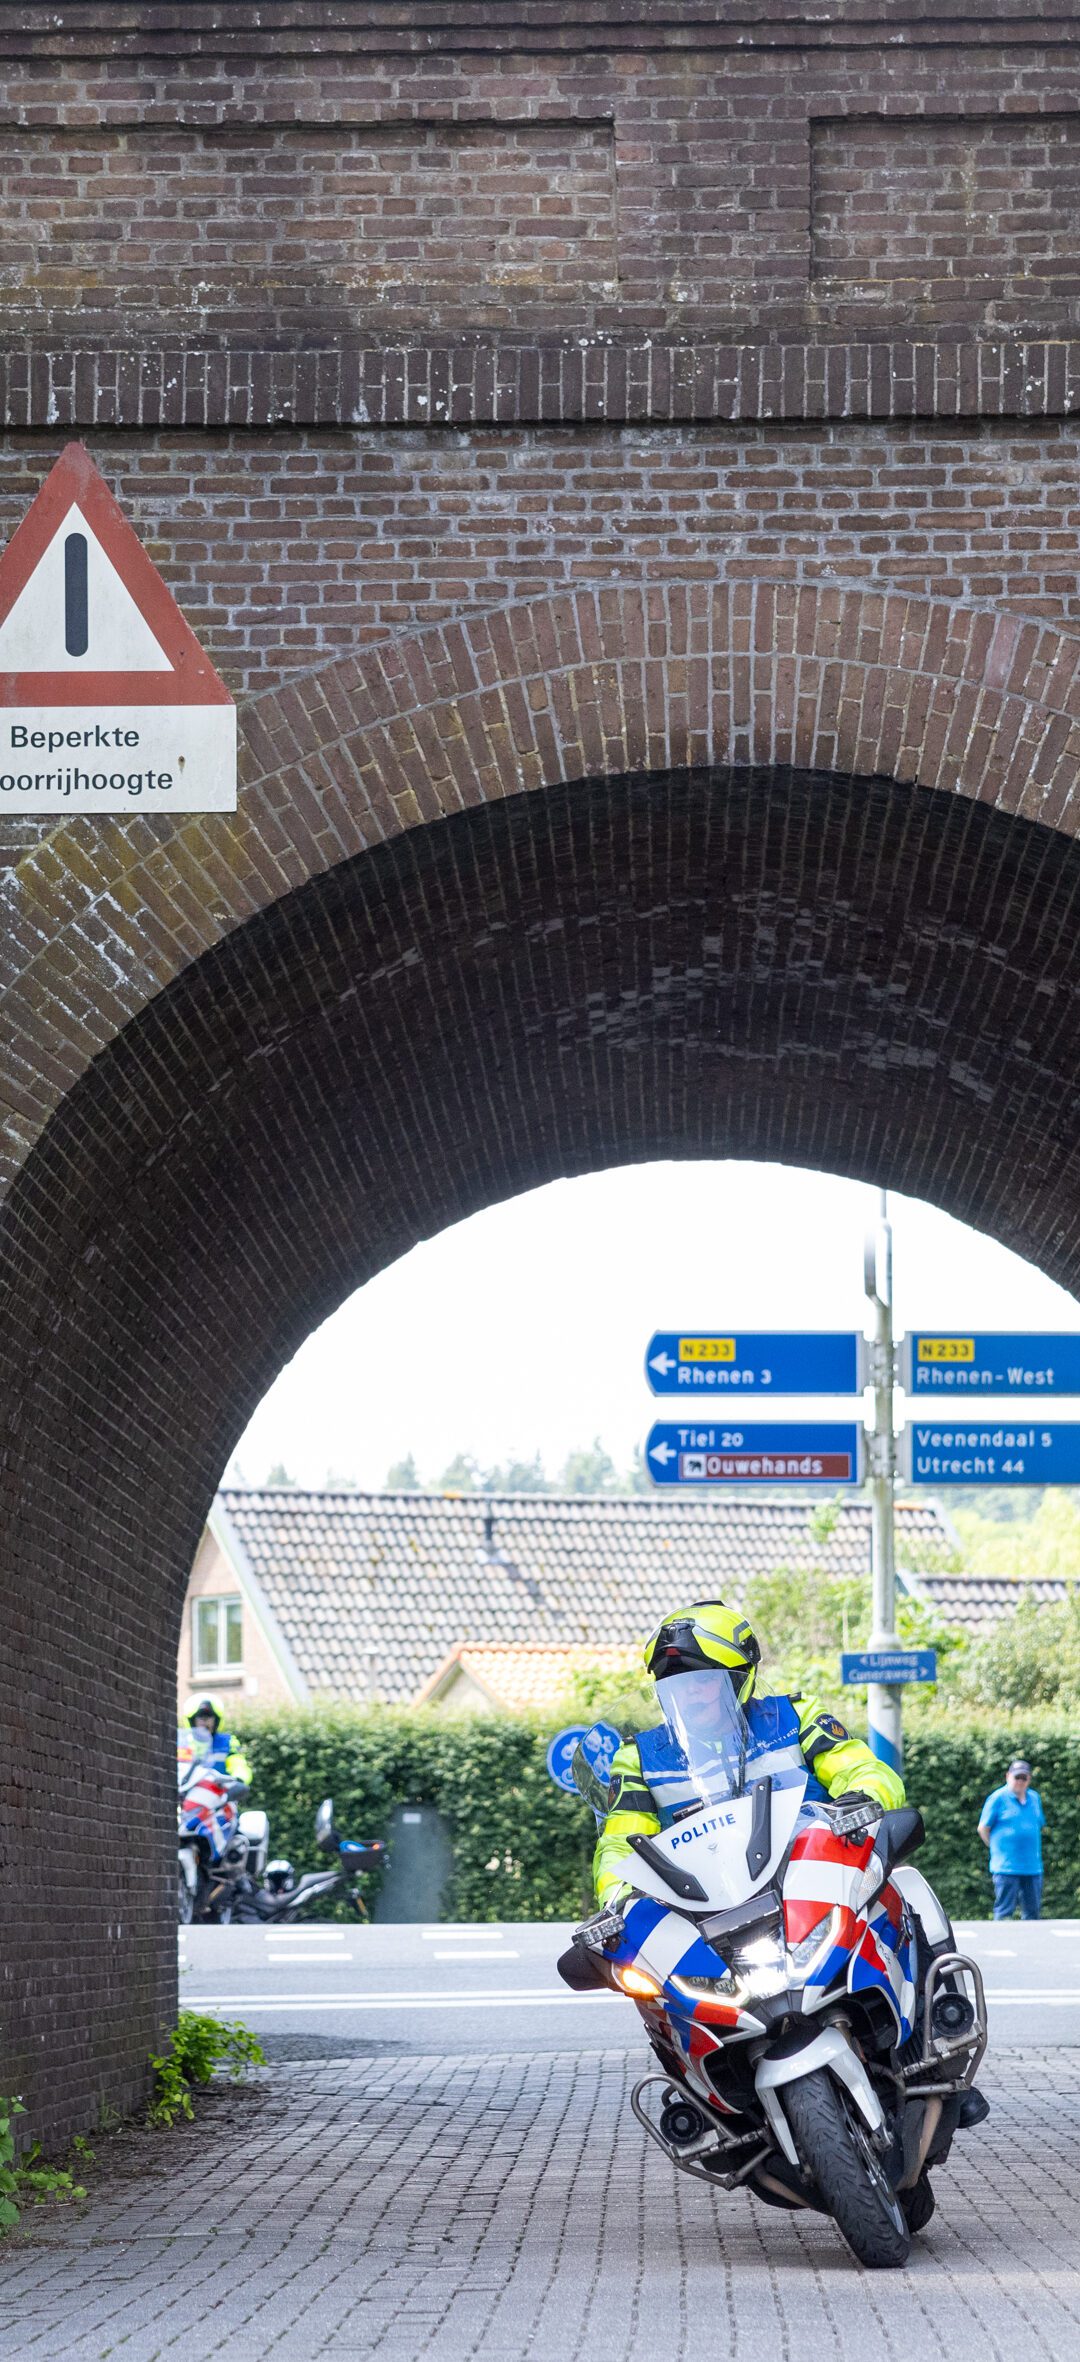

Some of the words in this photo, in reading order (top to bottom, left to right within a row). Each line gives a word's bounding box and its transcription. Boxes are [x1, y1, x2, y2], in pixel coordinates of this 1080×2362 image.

[11, 725, 140, 753] Beperkte
[0, 768, 173, 796] oorrijhoogte
[678, 1367, 754, 1384] Rhenen
[761, 1369, 772, 1384] 3
[678, 1430, 715, 1447] Tiel
[721, 1432, 744, 1447] 20
[917, 1430, 1035, 1447] Veenendaal
[1041, 1433, 1053, 1447] 5
[707, 1457, 823, 1474] Ouwehands
[917, 1457, 995, 1474] Utrecht
[1001, 1460, 1025, 1474] 44
[671, 1813, 736, 1850] POLITIE
